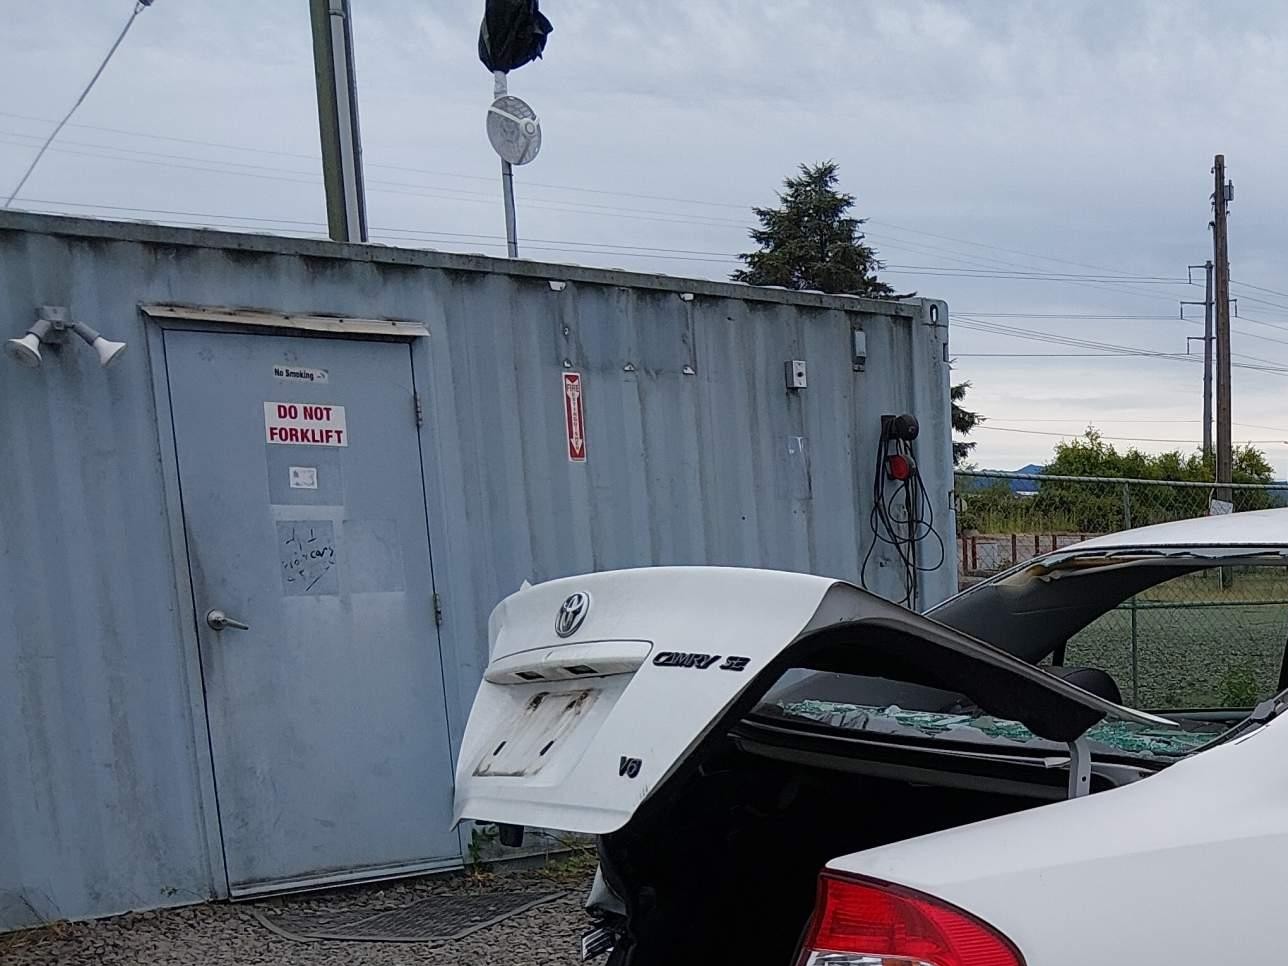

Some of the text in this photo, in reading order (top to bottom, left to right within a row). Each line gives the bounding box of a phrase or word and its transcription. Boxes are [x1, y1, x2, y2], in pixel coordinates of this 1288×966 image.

[274, 367, 314, 381] No Smoking
[277, 404, 332, 421] DO NOT
[269, 427, 343, 444] FORKLIFT
[652, 651, 751, 672] CAMRY SE
[618, 756, 642, 779] V6
